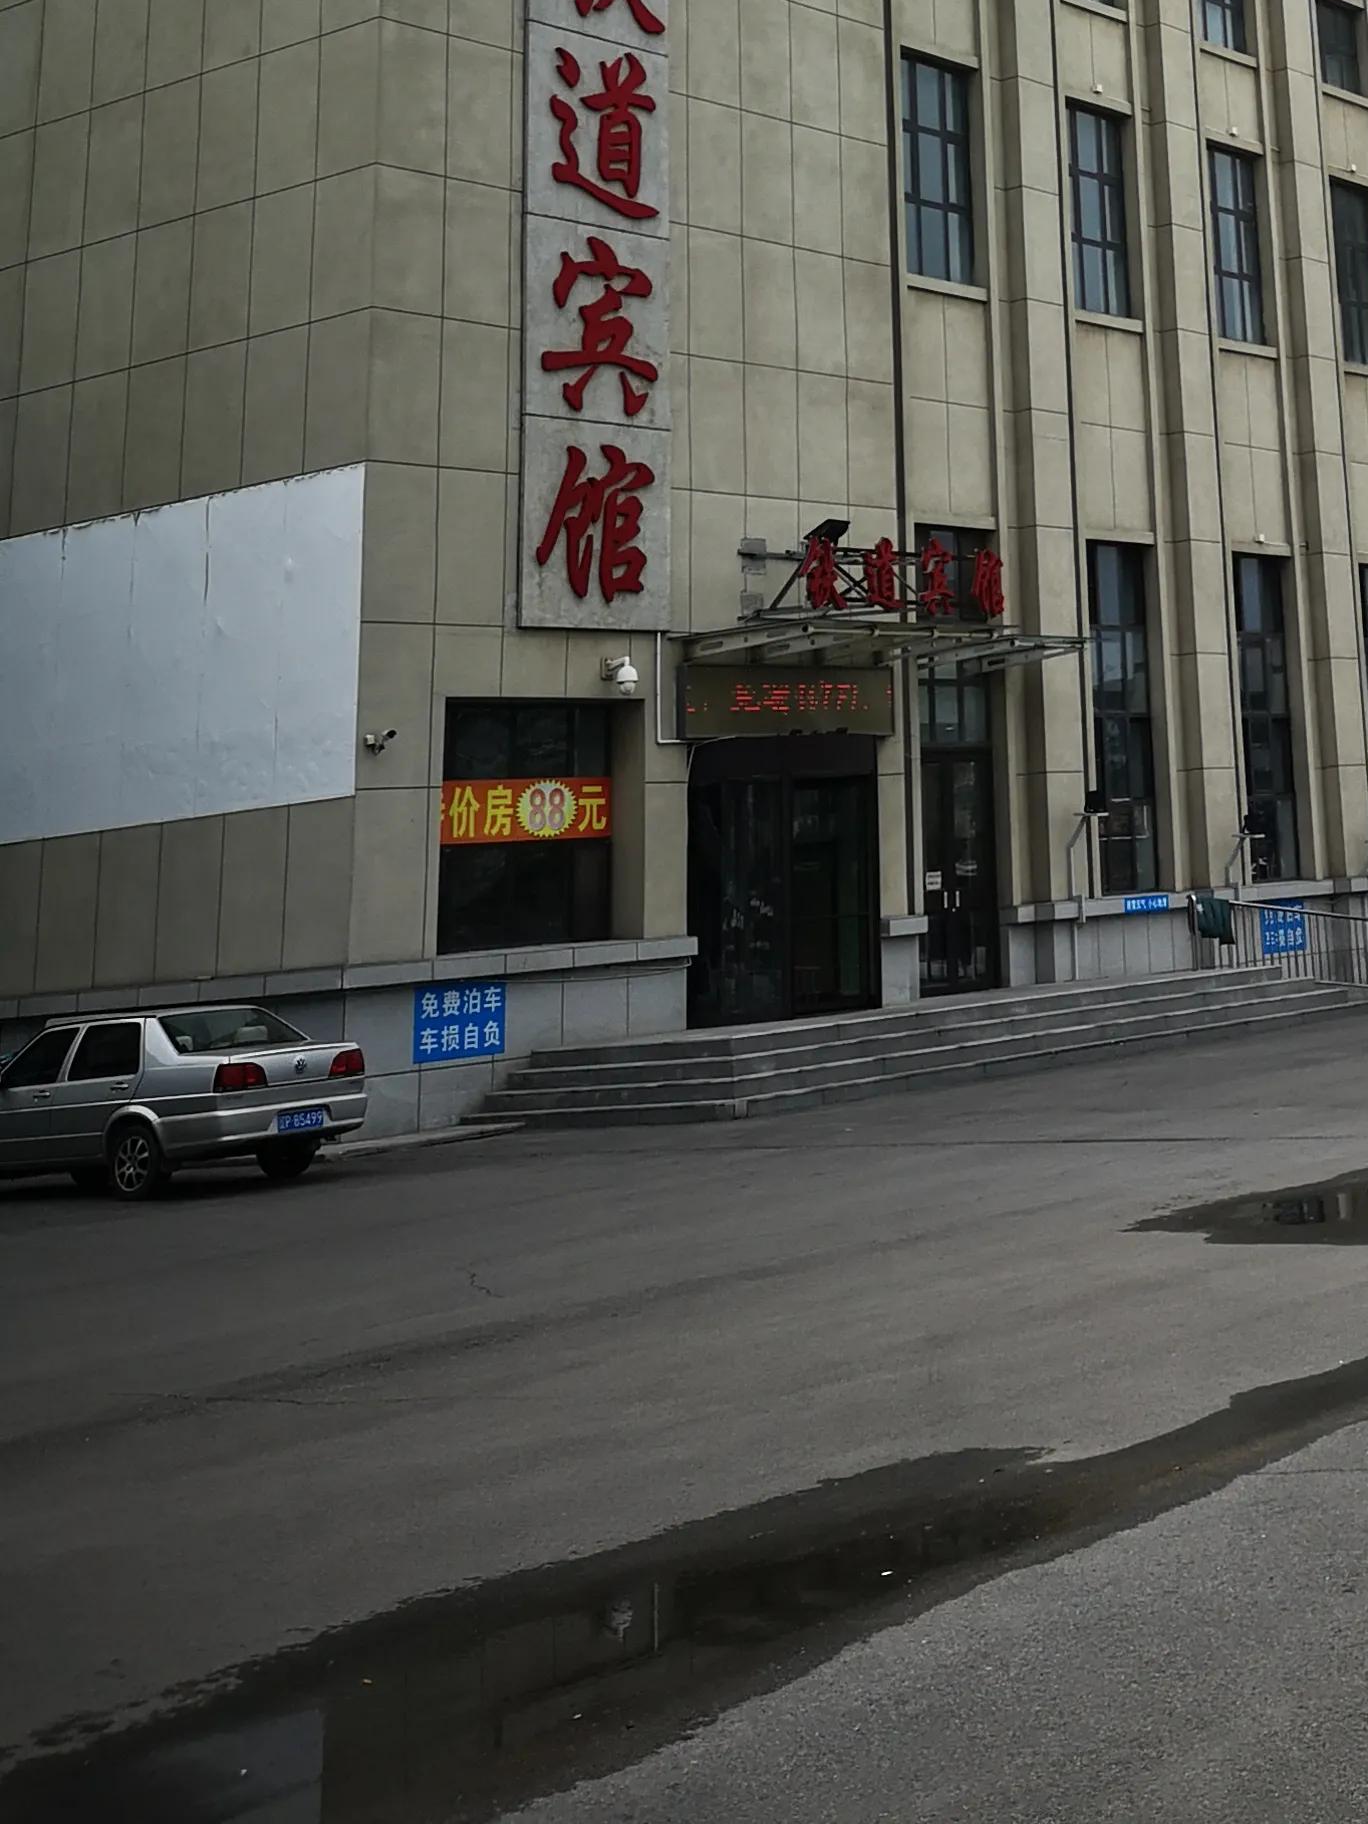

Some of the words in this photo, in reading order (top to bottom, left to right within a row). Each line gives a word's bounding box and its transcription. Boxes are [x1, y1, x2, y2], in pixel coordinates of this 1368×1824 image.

[440, 784, 607, 838] 价房88元
[421, 986, 502, 1019] 免费泊车
[419, 1021, 501, 1055] 车损自负
